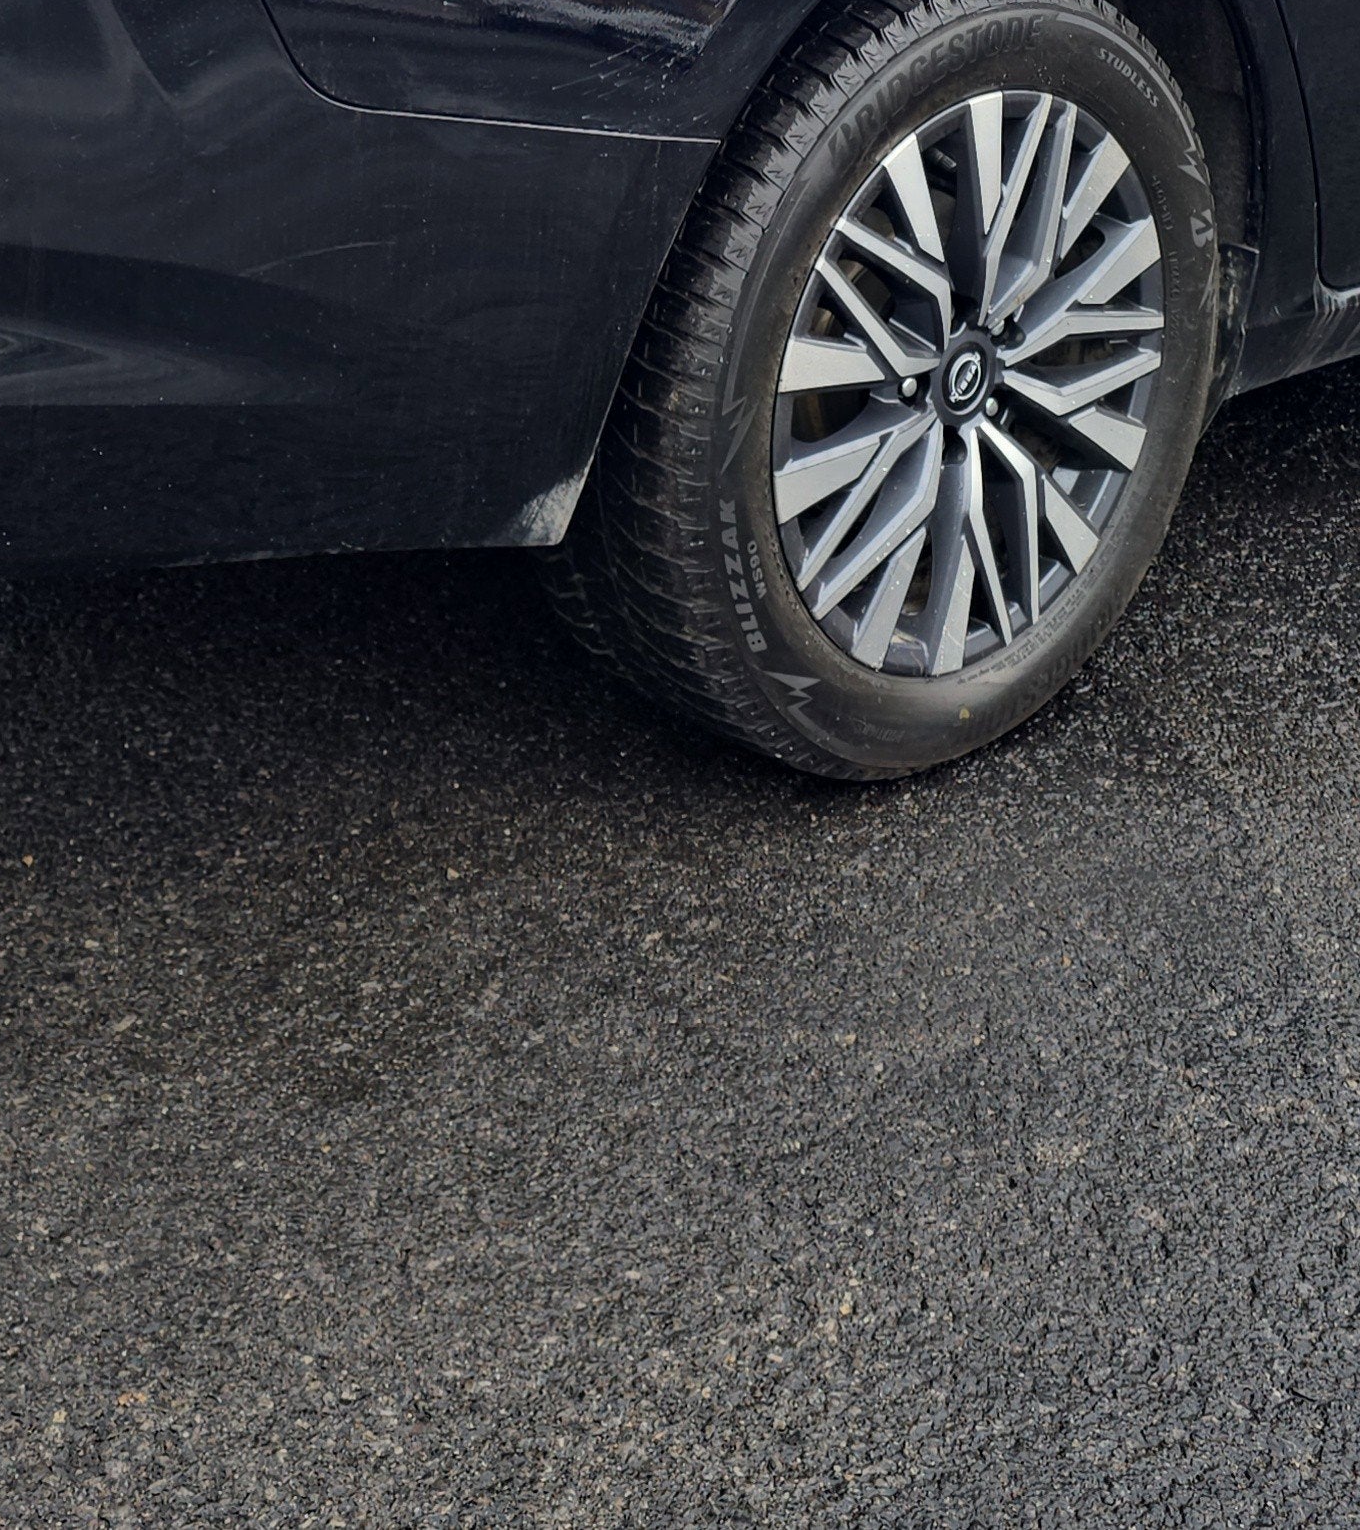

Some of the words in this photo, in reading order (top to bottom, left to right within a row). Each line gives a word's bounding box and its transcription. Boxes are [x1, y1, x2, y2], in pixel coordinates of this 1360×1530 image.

[1097, 47, 1160, 108] STUDLESS
[719, 498, 768, 654] BLIZZAK
[746, 539, 768, 600] WS90
